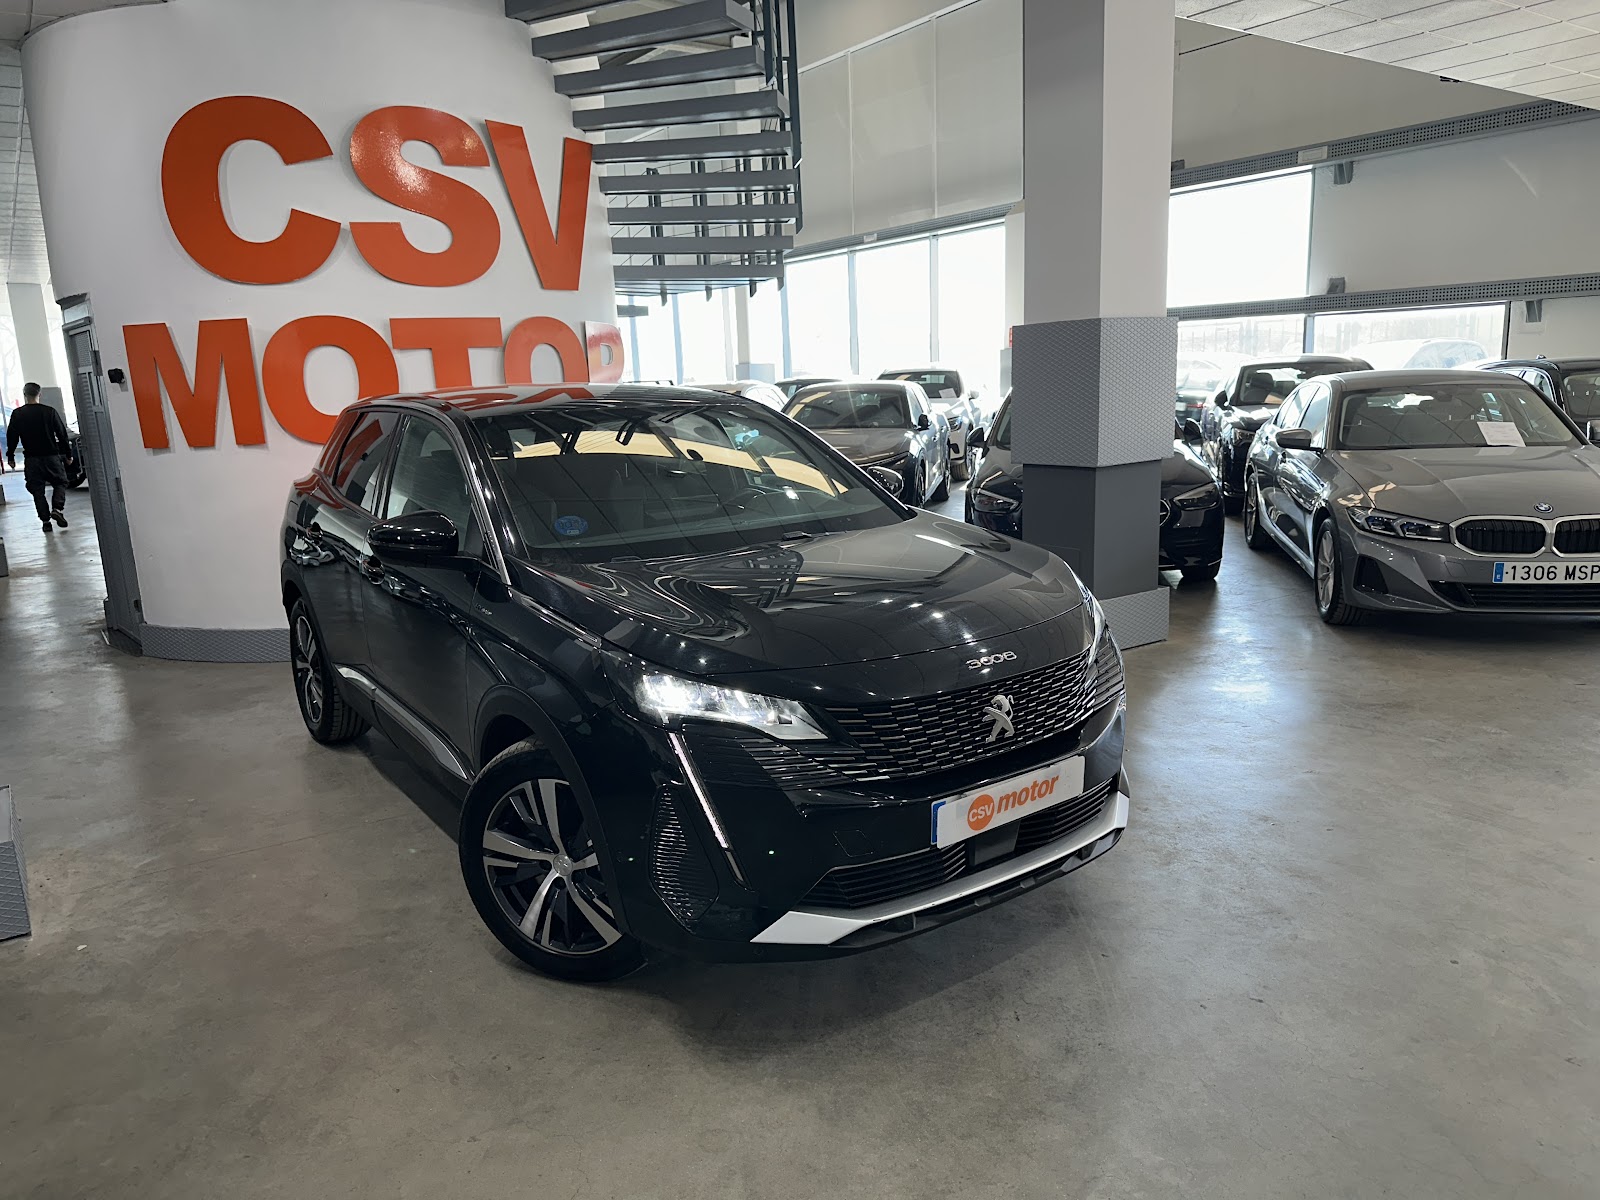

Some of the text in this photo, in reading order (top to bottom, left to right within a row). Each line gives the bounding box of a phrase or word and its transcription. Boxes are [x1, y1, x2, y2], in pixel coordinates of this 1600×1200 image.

[161, 95, 593, 291] CSV
[1511, 565, 1600, 581] 1306 MSP
[965, 651, 1017, 670] 3008
[996, 774, 1059, 814] motor
